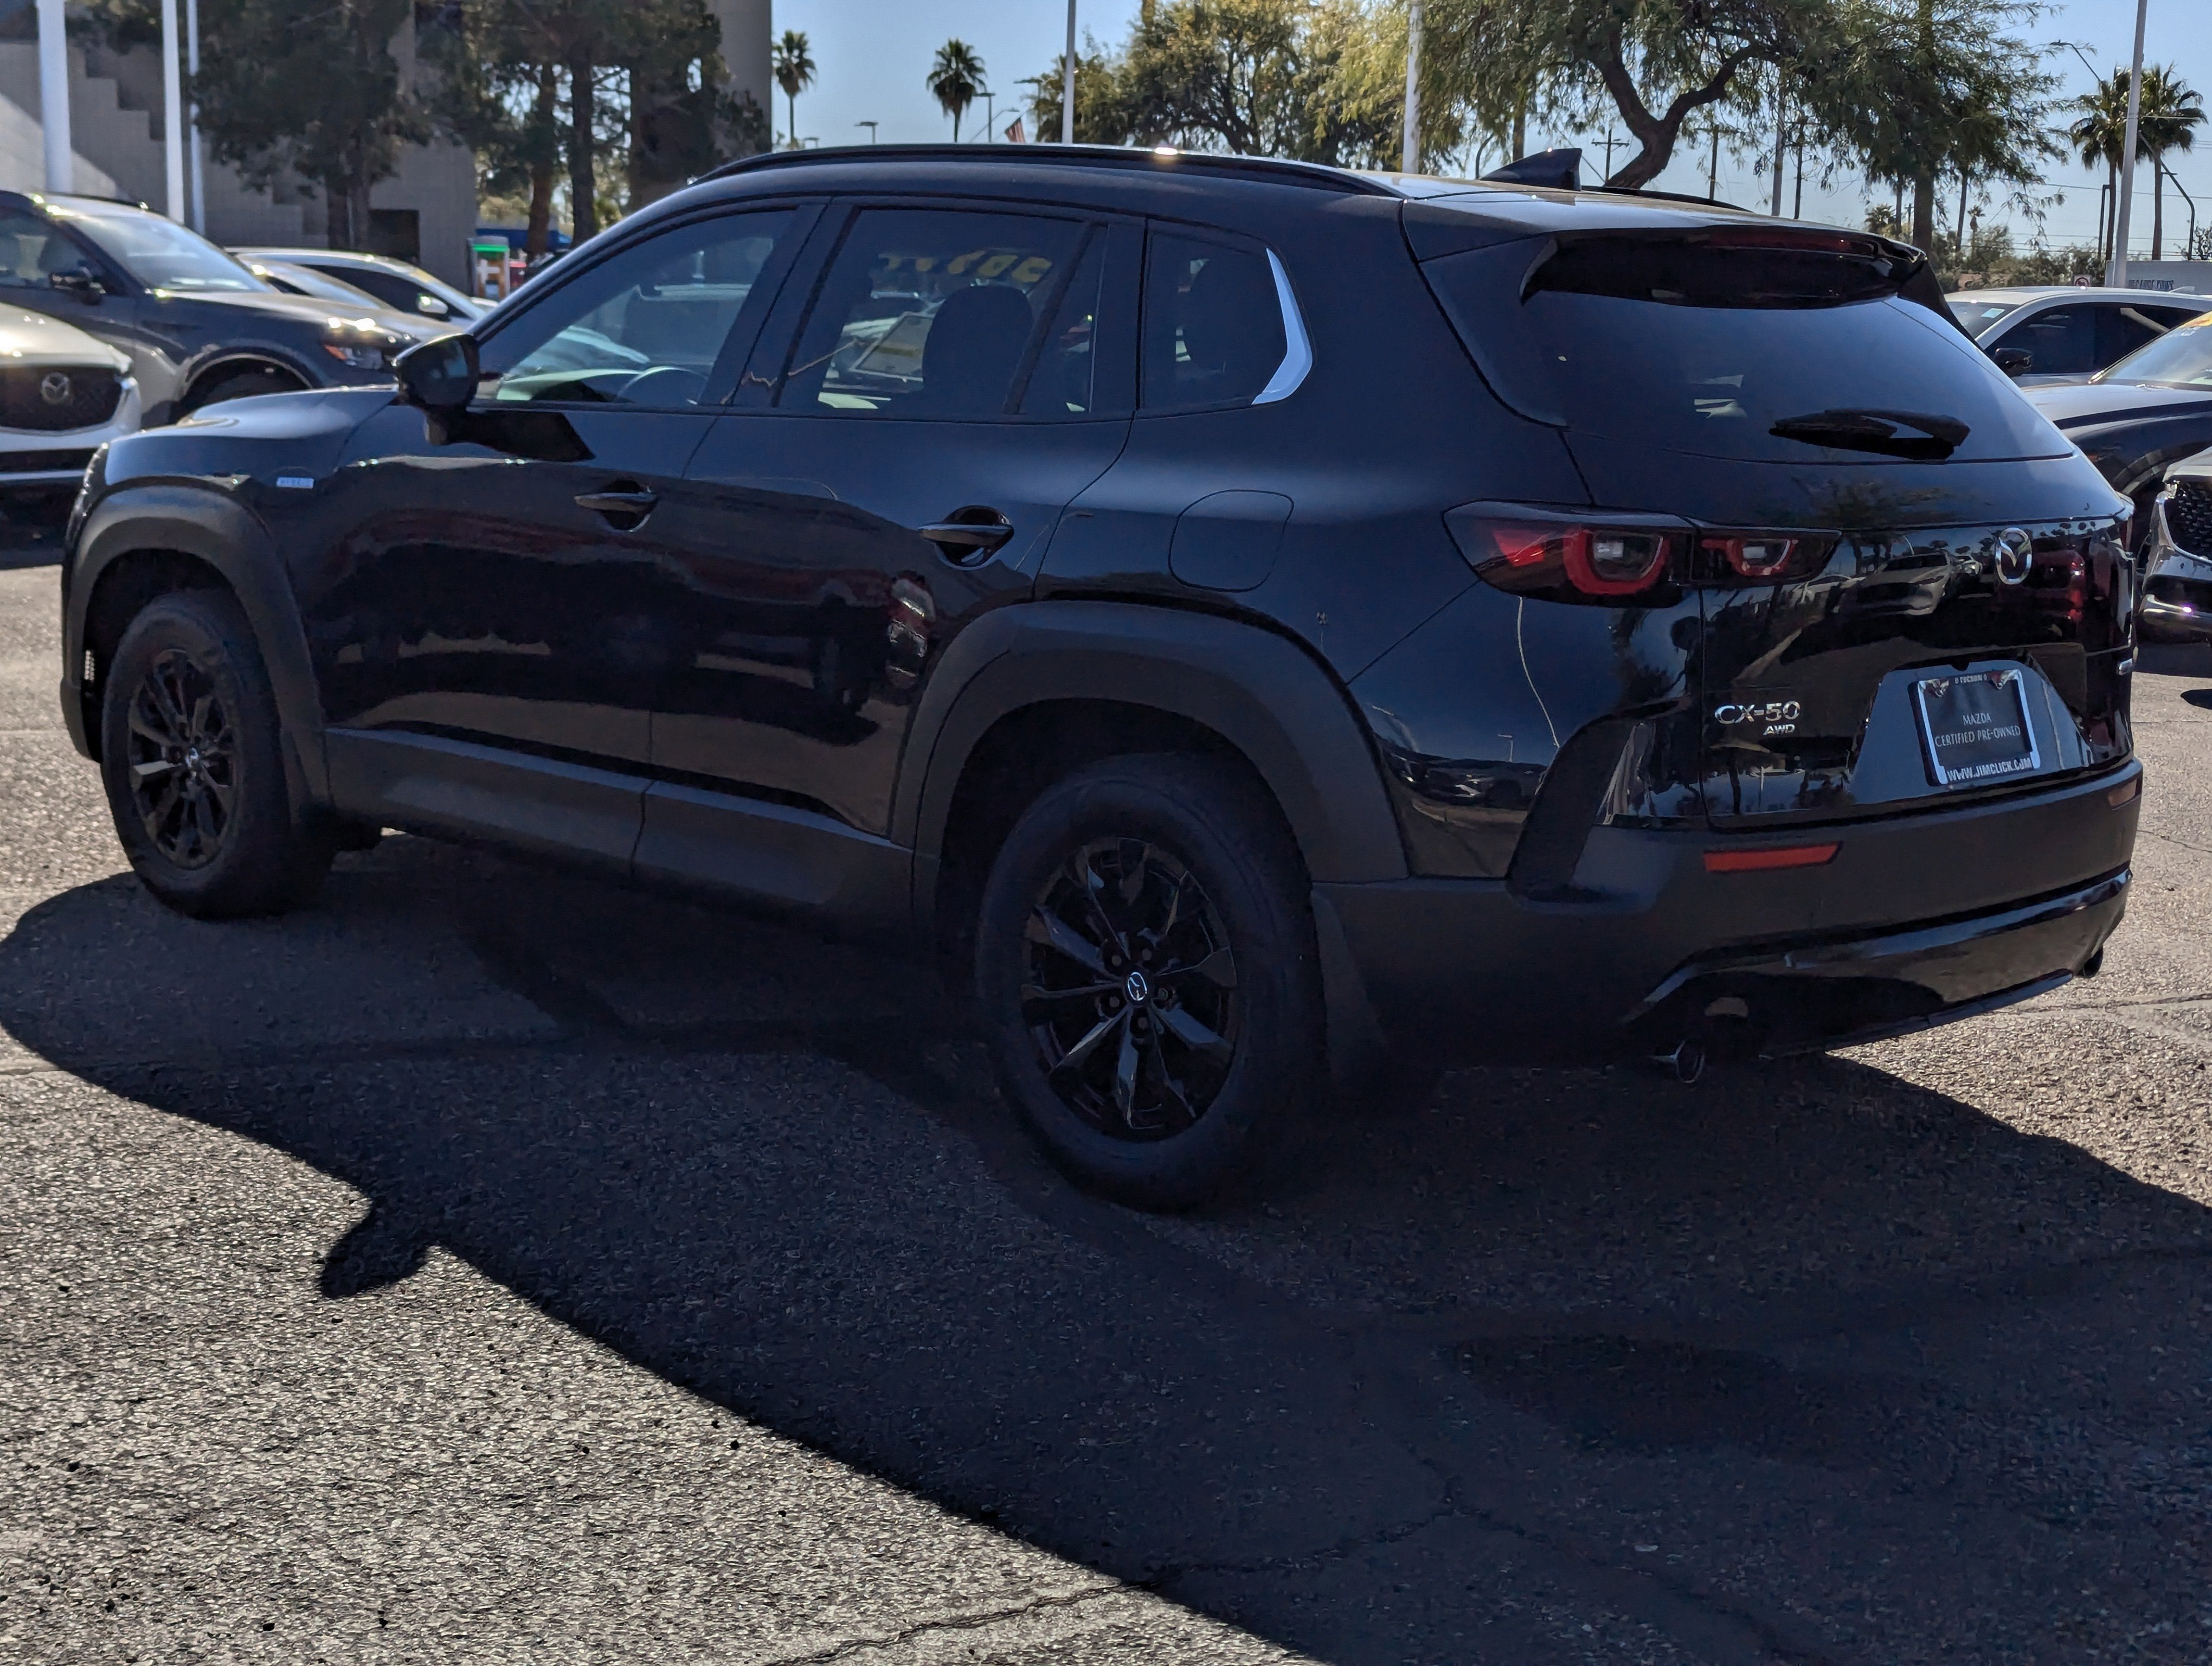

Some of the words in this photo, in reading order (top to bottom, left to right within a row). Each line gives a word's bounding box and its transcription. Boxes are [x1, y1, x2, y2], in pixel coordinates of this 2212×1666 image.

[1714, 701, 1801, 724] CX-50
[1962, 712, 1992, 726] MAZDA
[1763, 723, 1796, 736] AWD
[1934, 731, 1976, 747] CERTIFIED
[1977, 725, 2021, 741] PRE-OWNED
